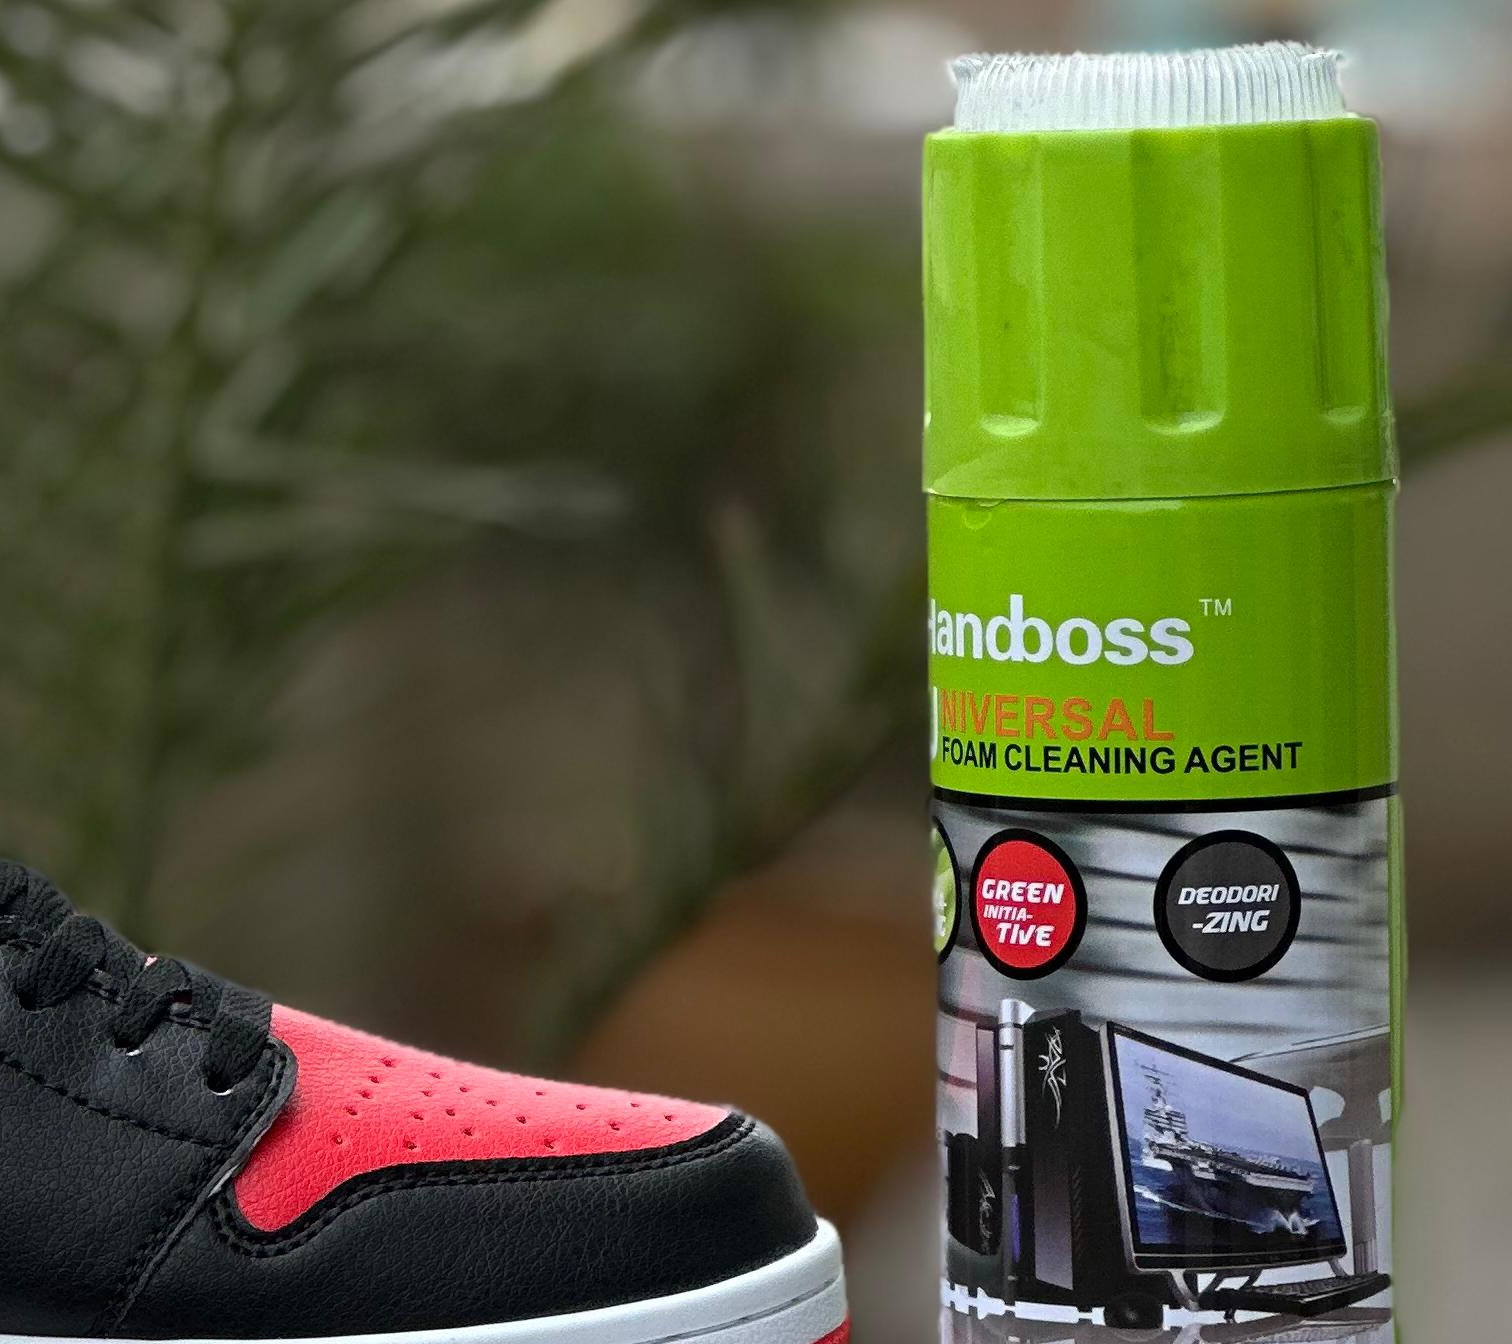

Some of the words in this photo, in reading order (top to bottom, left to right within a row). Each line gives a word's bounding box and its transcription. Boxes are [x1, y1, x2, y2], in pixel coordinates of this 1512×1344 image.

[942, 735, 997, 770] FOAM
[1004, 743, 1176, 775] CLEANING
[1183, 741, 1303, 775] AGENT
[981, 878, 1065, 905] GREEN
[1177, 884, 1281, 905] DEODORI
[983, 904, 1034, 922] INITIA-
[1192, 909, 1271, 934] -ZING
[995, 921, 1056, 948] TIVE
